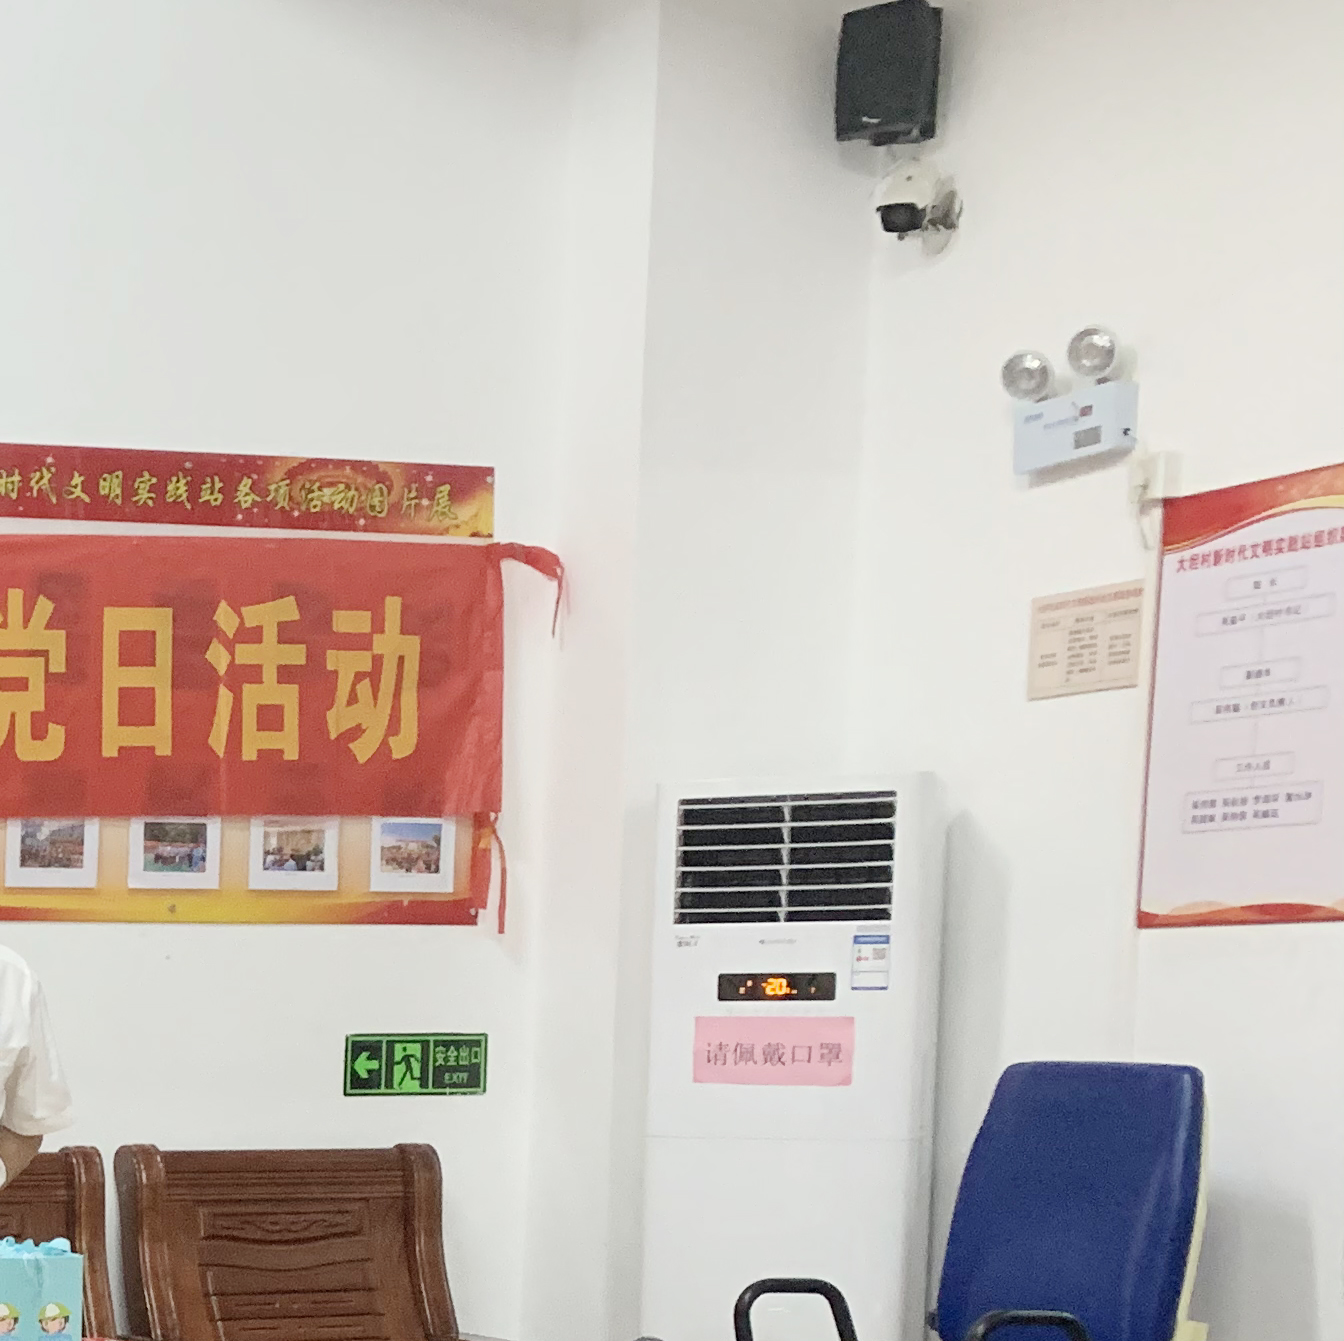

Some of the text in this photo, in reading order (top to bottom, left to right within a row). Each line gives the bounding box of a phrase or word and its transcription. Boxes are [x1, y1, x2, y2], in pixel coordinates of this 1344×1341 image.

[434, 1045, 481, 1066] 安全出口
[705, 1042, 843, 1067] 请佩戴口罩
[444, 1072, 470, 1084] EXIT
